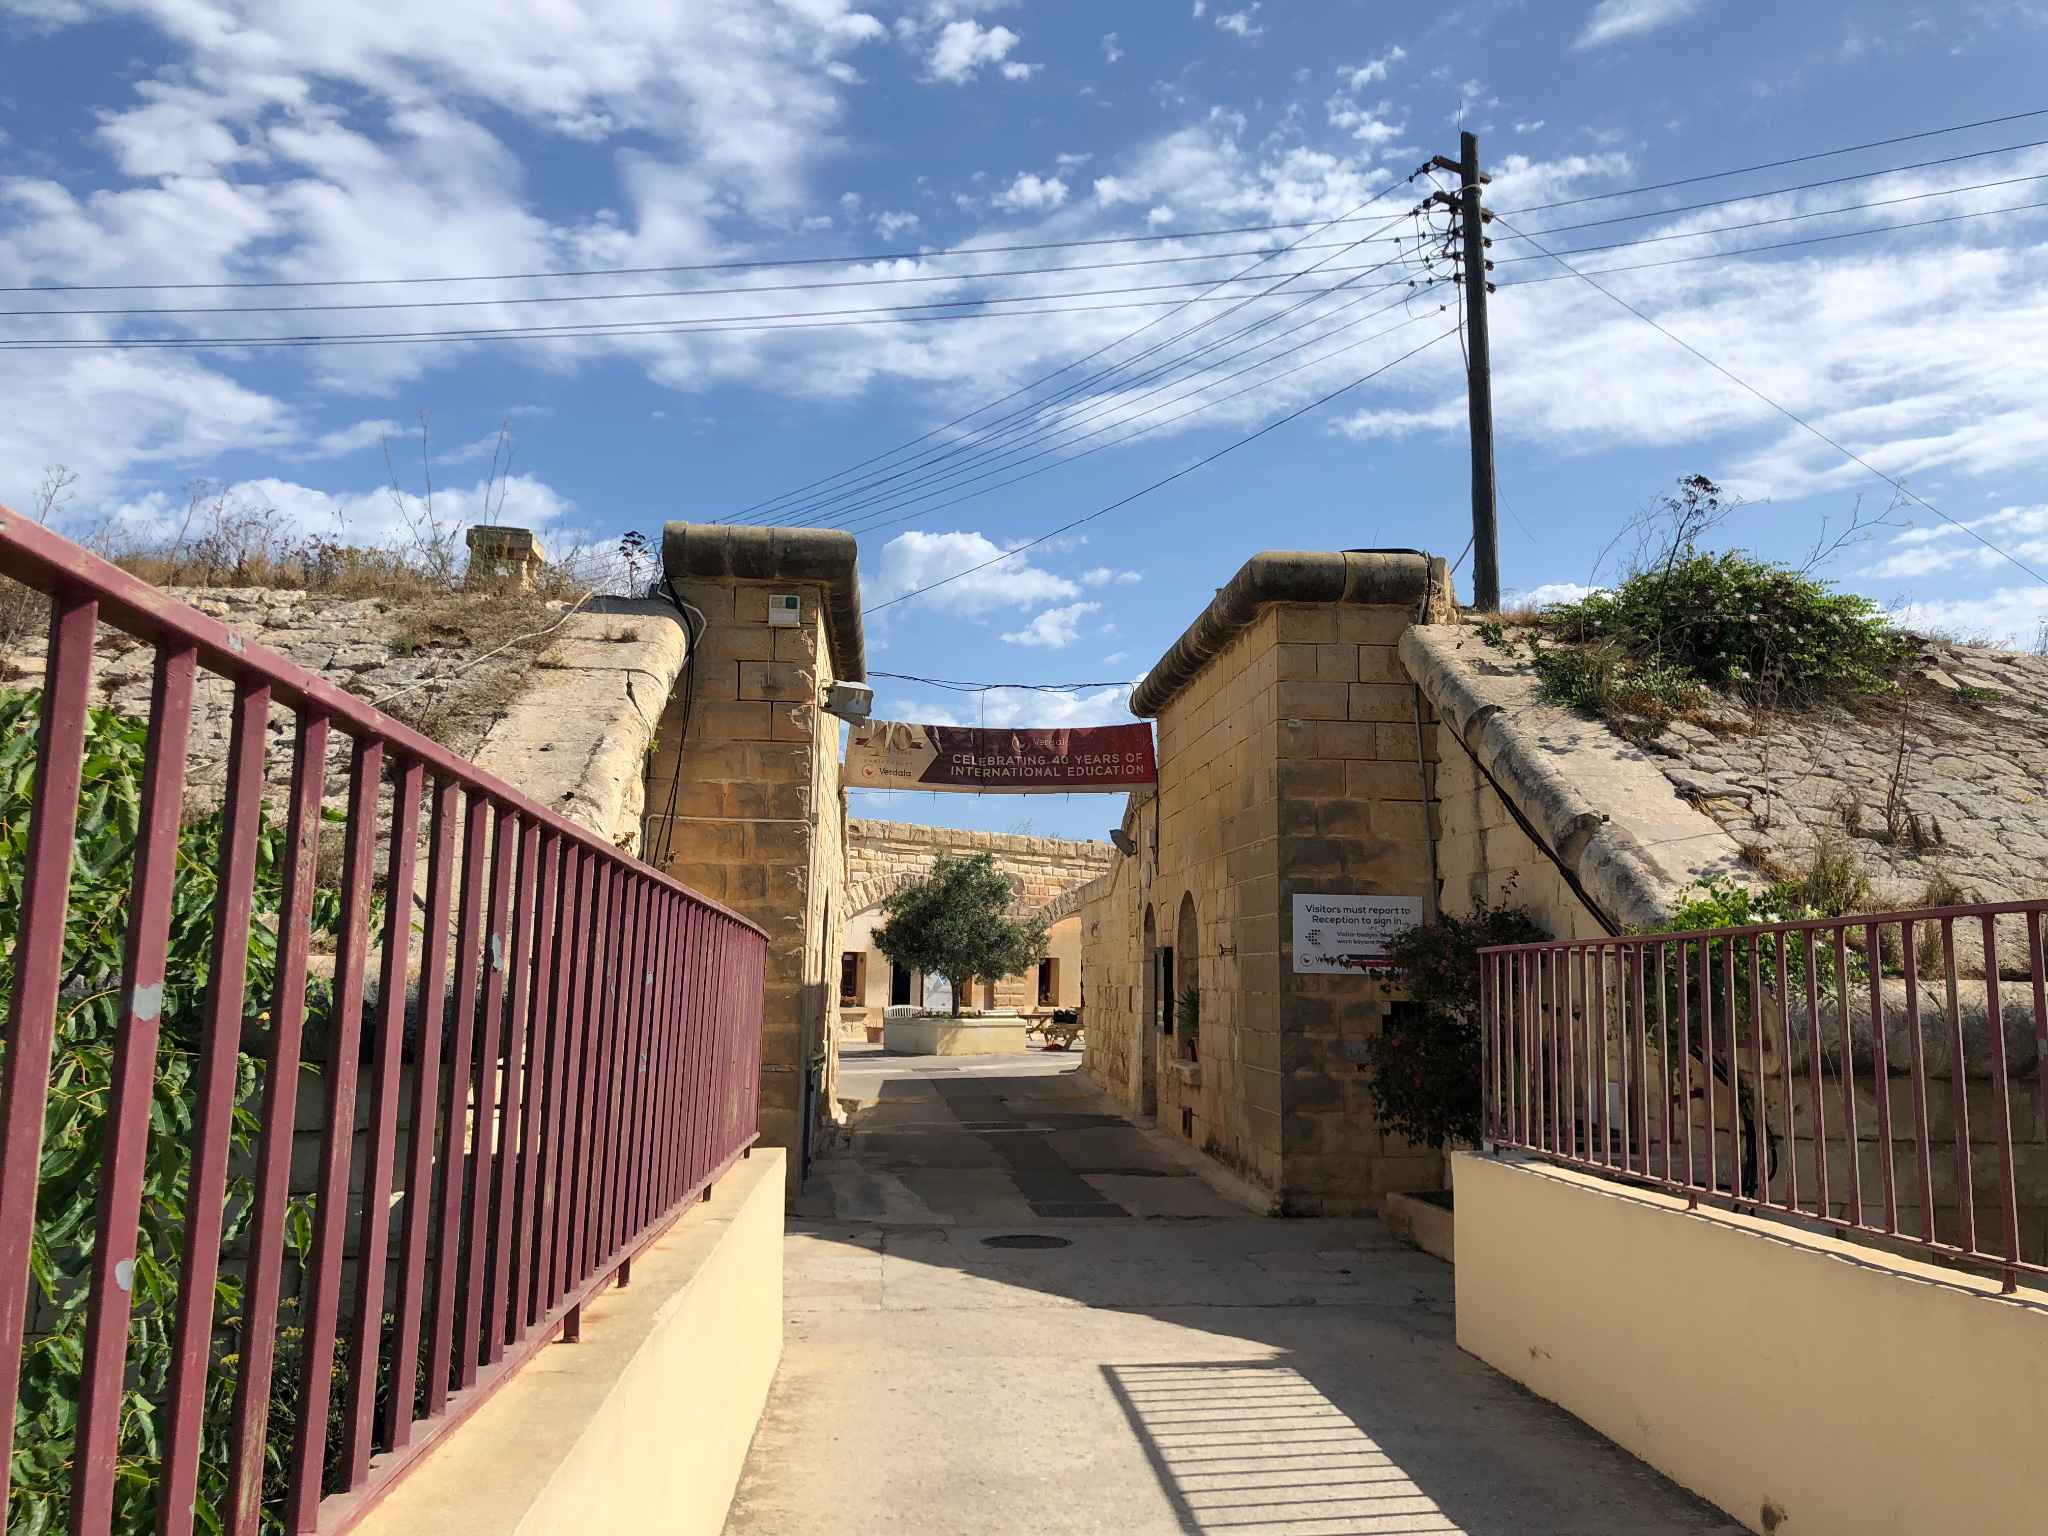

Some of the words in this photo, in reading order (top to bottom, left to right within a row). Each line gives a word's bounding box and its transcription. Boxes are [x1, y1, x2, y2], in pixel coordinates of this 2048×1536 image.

[952, 753, 1046, 767] CELEBRATING
[1052, 755, 1069, 765] 40
[1074, 753, 1120, 765] YEARS
[1126, 752, 1143, 763] OF
[879, 767, 912, 777] Verdala
[951, 765, 1061, 777] INTERNATIONAL
[1067, 764, 1144, 777] EDUCATION
[1305, 904, 1341, 914] Visitors
[1343, 905, 1366, 915] must
[1368, 906, 1399, 917] report
[1401, 906, 1411, 915] to
[1312, 915, 1360, 926] Reception
[1361, 916, 1371, 925] to
[1373, 916, 1392, 928] sign
